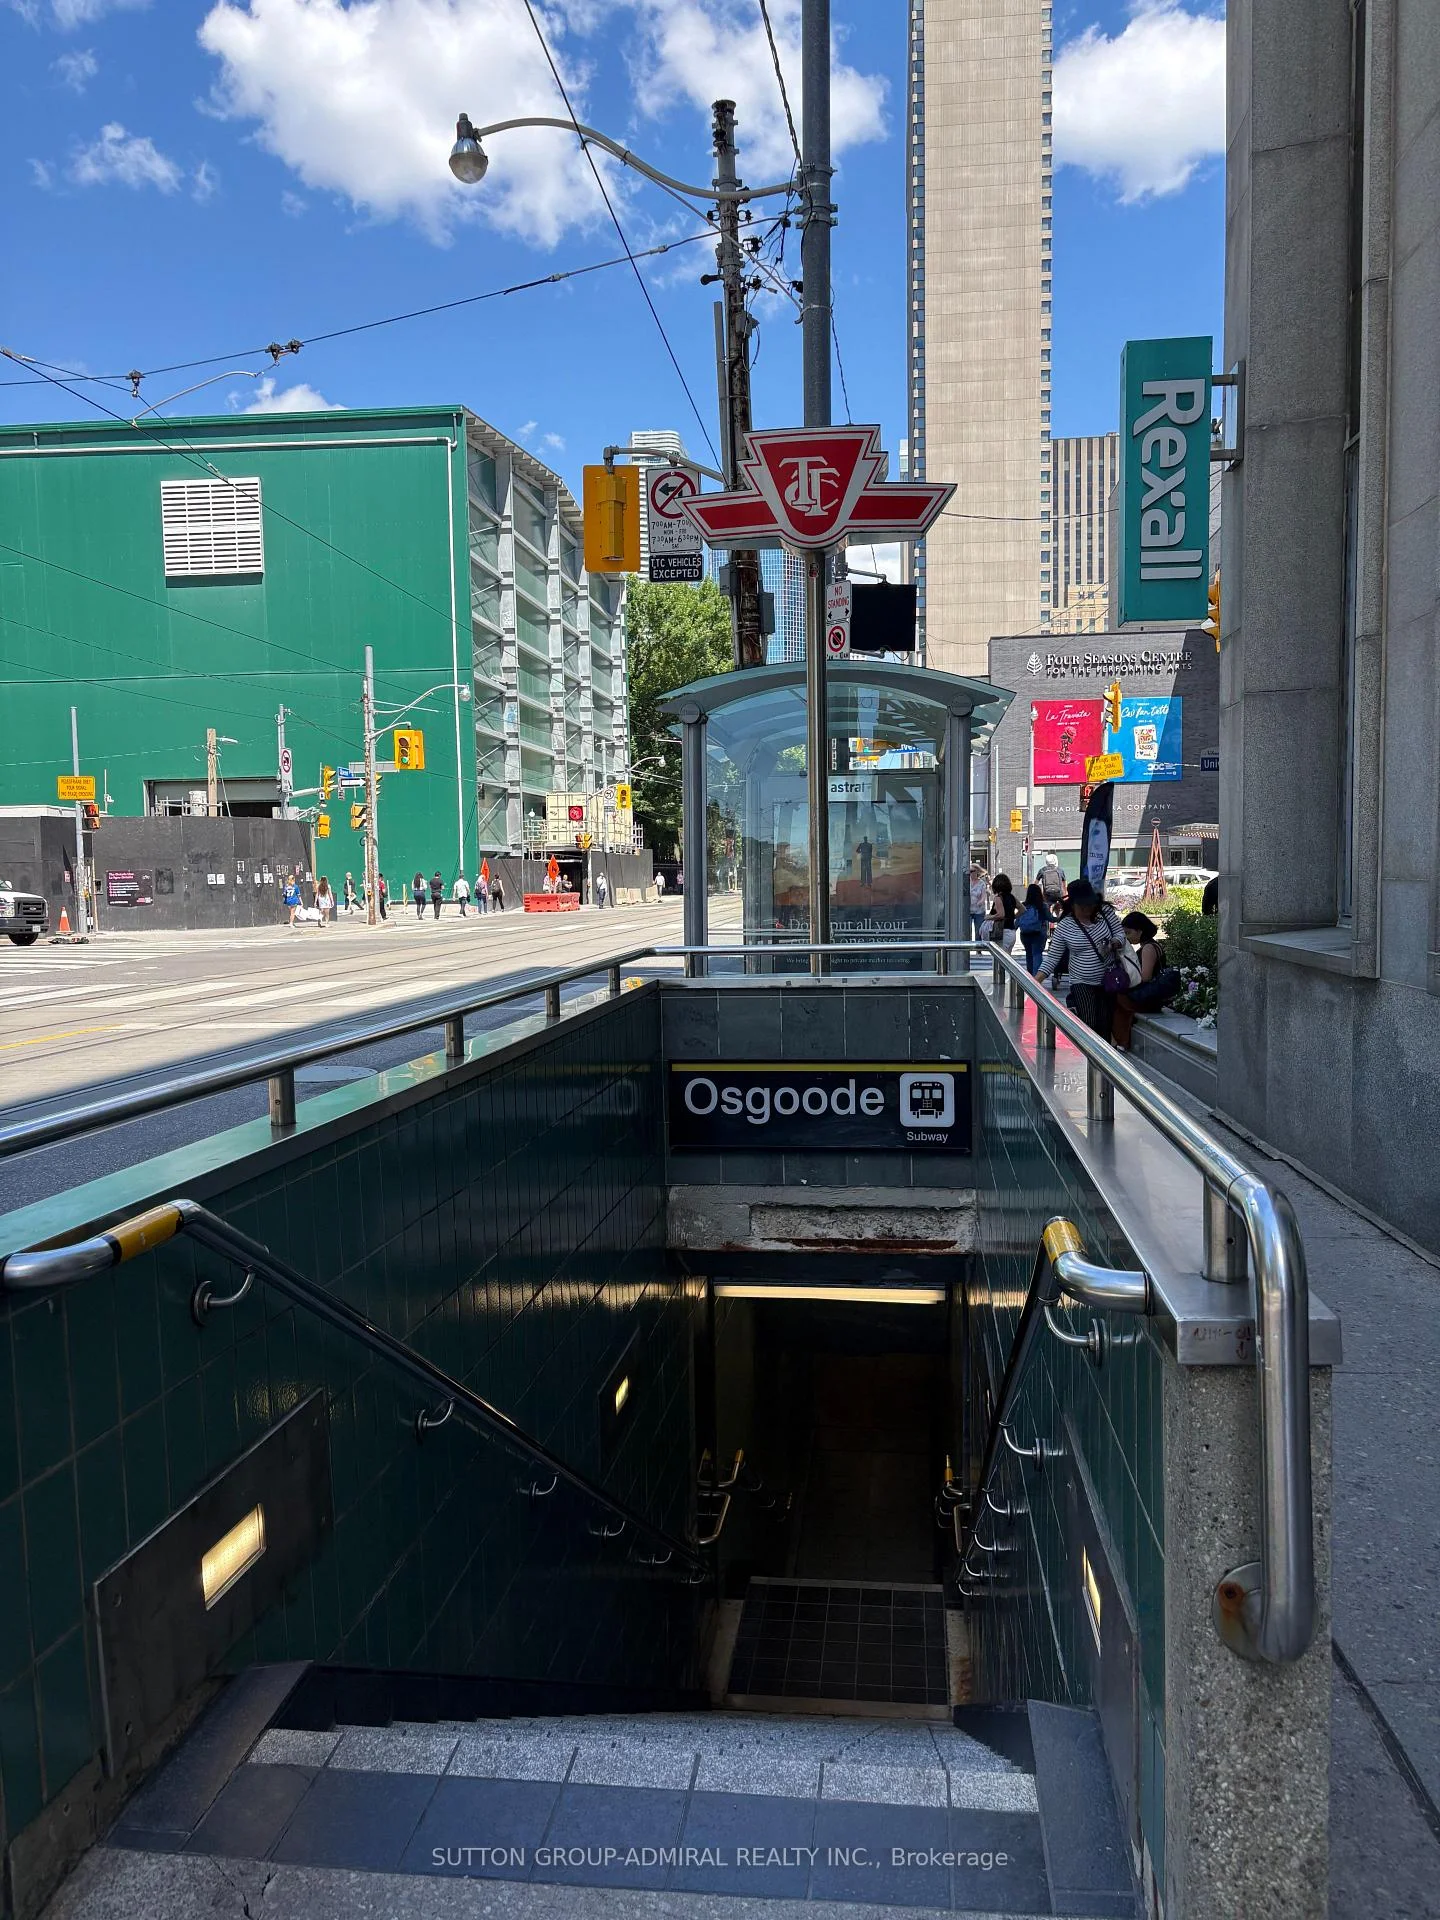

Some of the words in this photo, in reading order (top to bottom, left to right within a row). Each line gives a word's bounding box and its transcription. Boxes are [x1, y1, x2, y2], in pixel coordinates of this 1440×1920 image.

[1132, 378, 1206, 580] Rexall
[650, 558, 666, 568] TTC
[668, 558, 702, 567] VEHICLES
[652, 568, 700, 578] EXCEPTED
[834, 586, 842, 596] NO
[1046, 654, 1080, 666] FOUR
[1084, 652, 1137, 664] SEASONS
[1141, 650, 1192, 663] CENTRE
[1072, 666, 1091, 674] THE
[1096, 663, 1162, 673] PERFORMING
[1167, 662, 1192, 670] ARTS
[1204, 758, 1218, 769] Uni
[830, 782, 864, 793] astral
[856, 918, 872, 930] all
[875, 921, 908, 934] your
[684, 1077, 885, 1125] Osgoode
[906, 1131, 949, 1144] Subway
